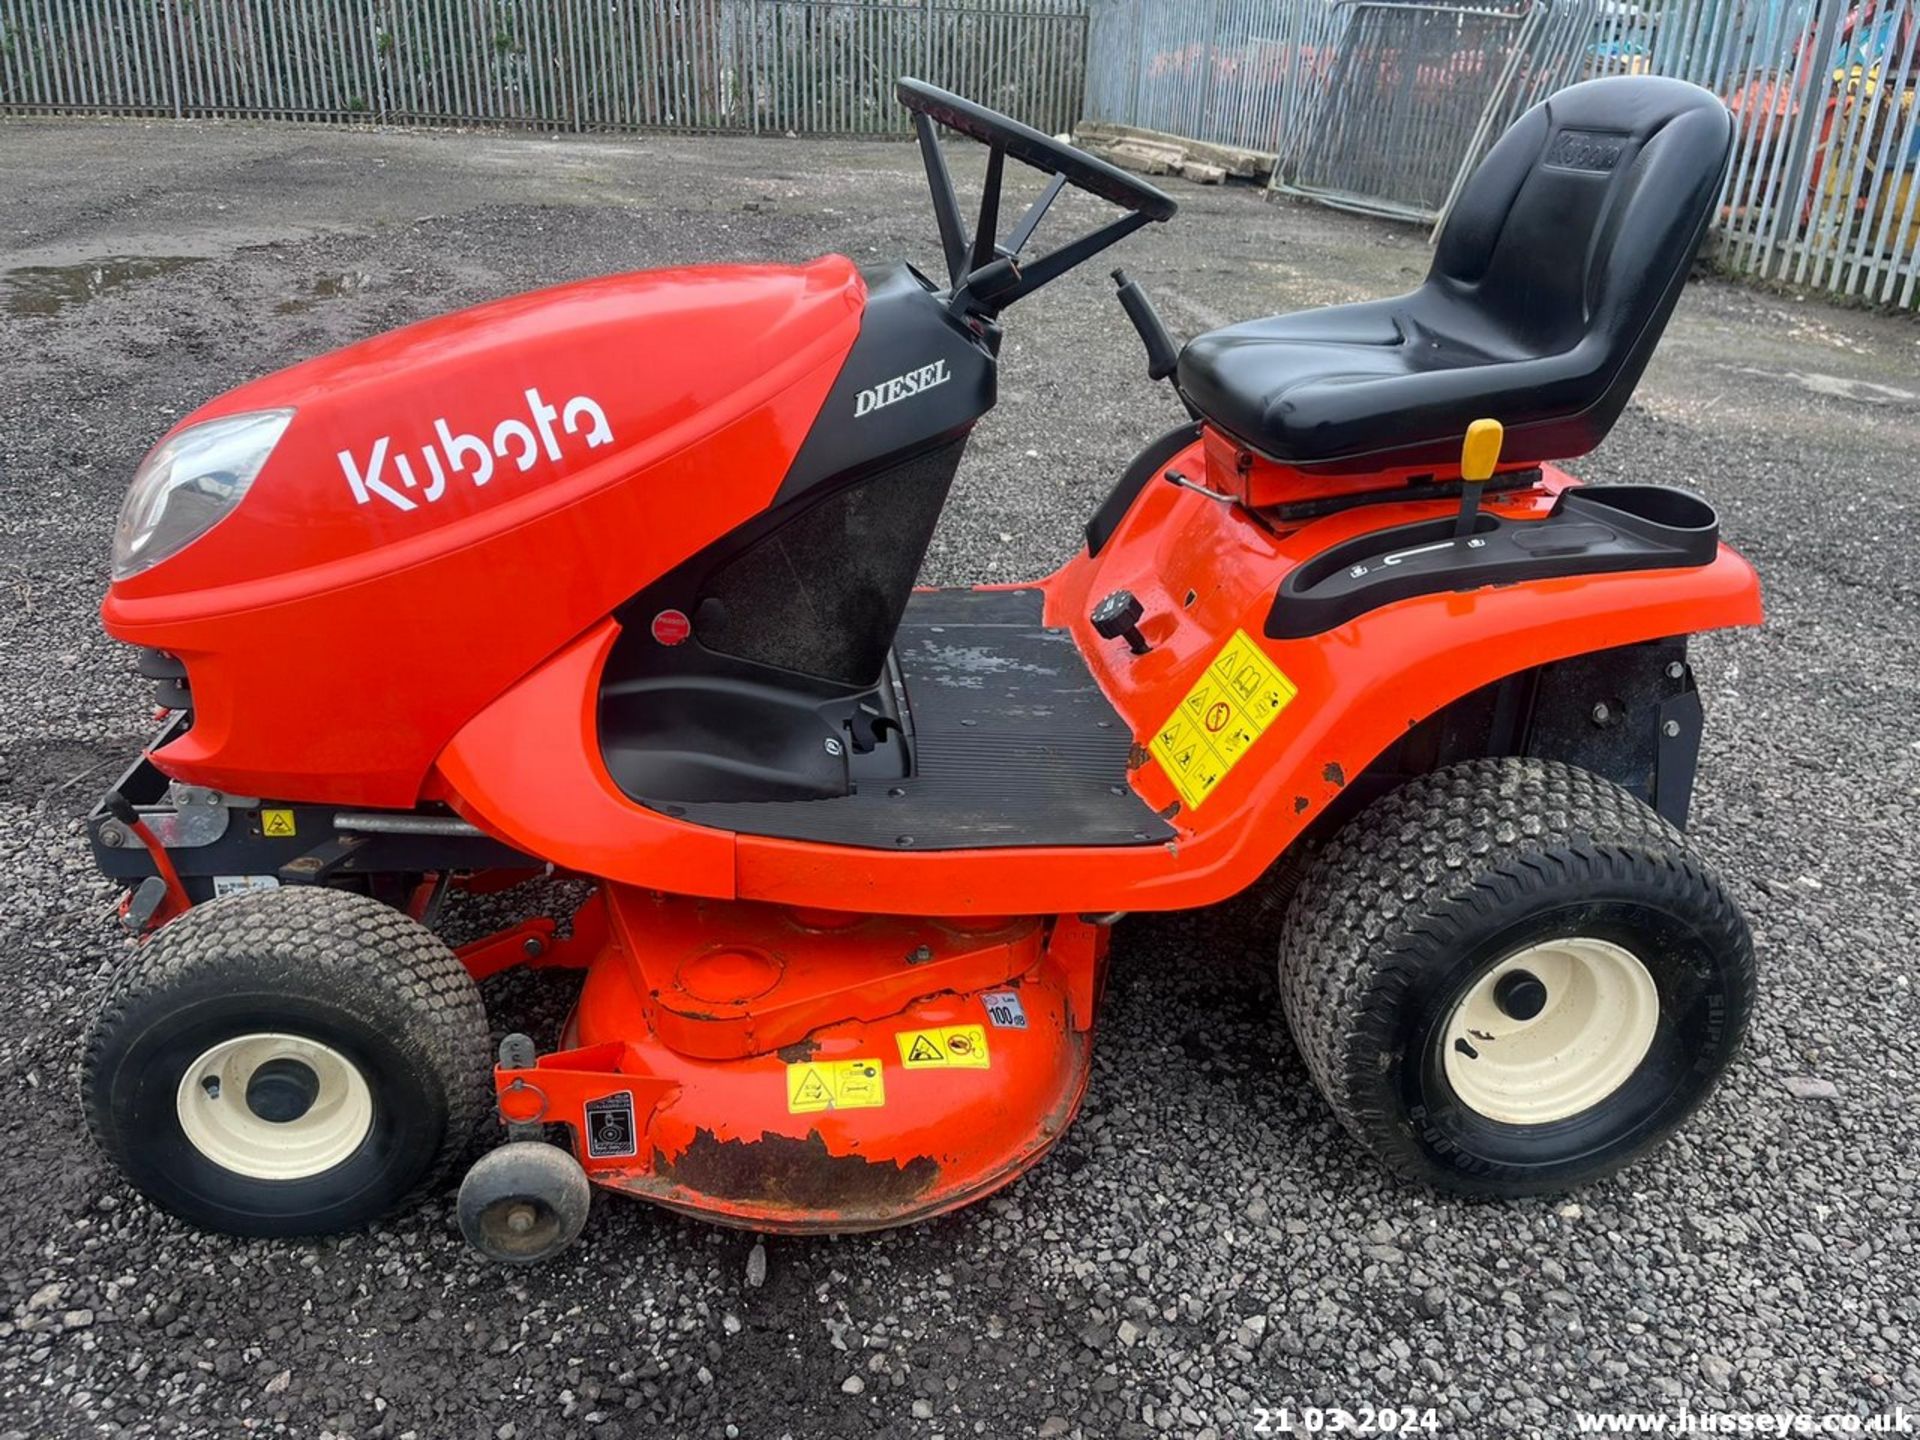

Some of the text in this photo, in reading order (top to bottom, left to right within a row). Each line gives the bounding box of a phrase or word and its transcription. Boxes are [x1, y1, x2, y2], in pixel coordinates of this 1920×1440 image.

[854, 359, 951, 418] DIESEL
[337, 388, 615, 511] Kubota
[989, 1006, 1013, 1025] 100
